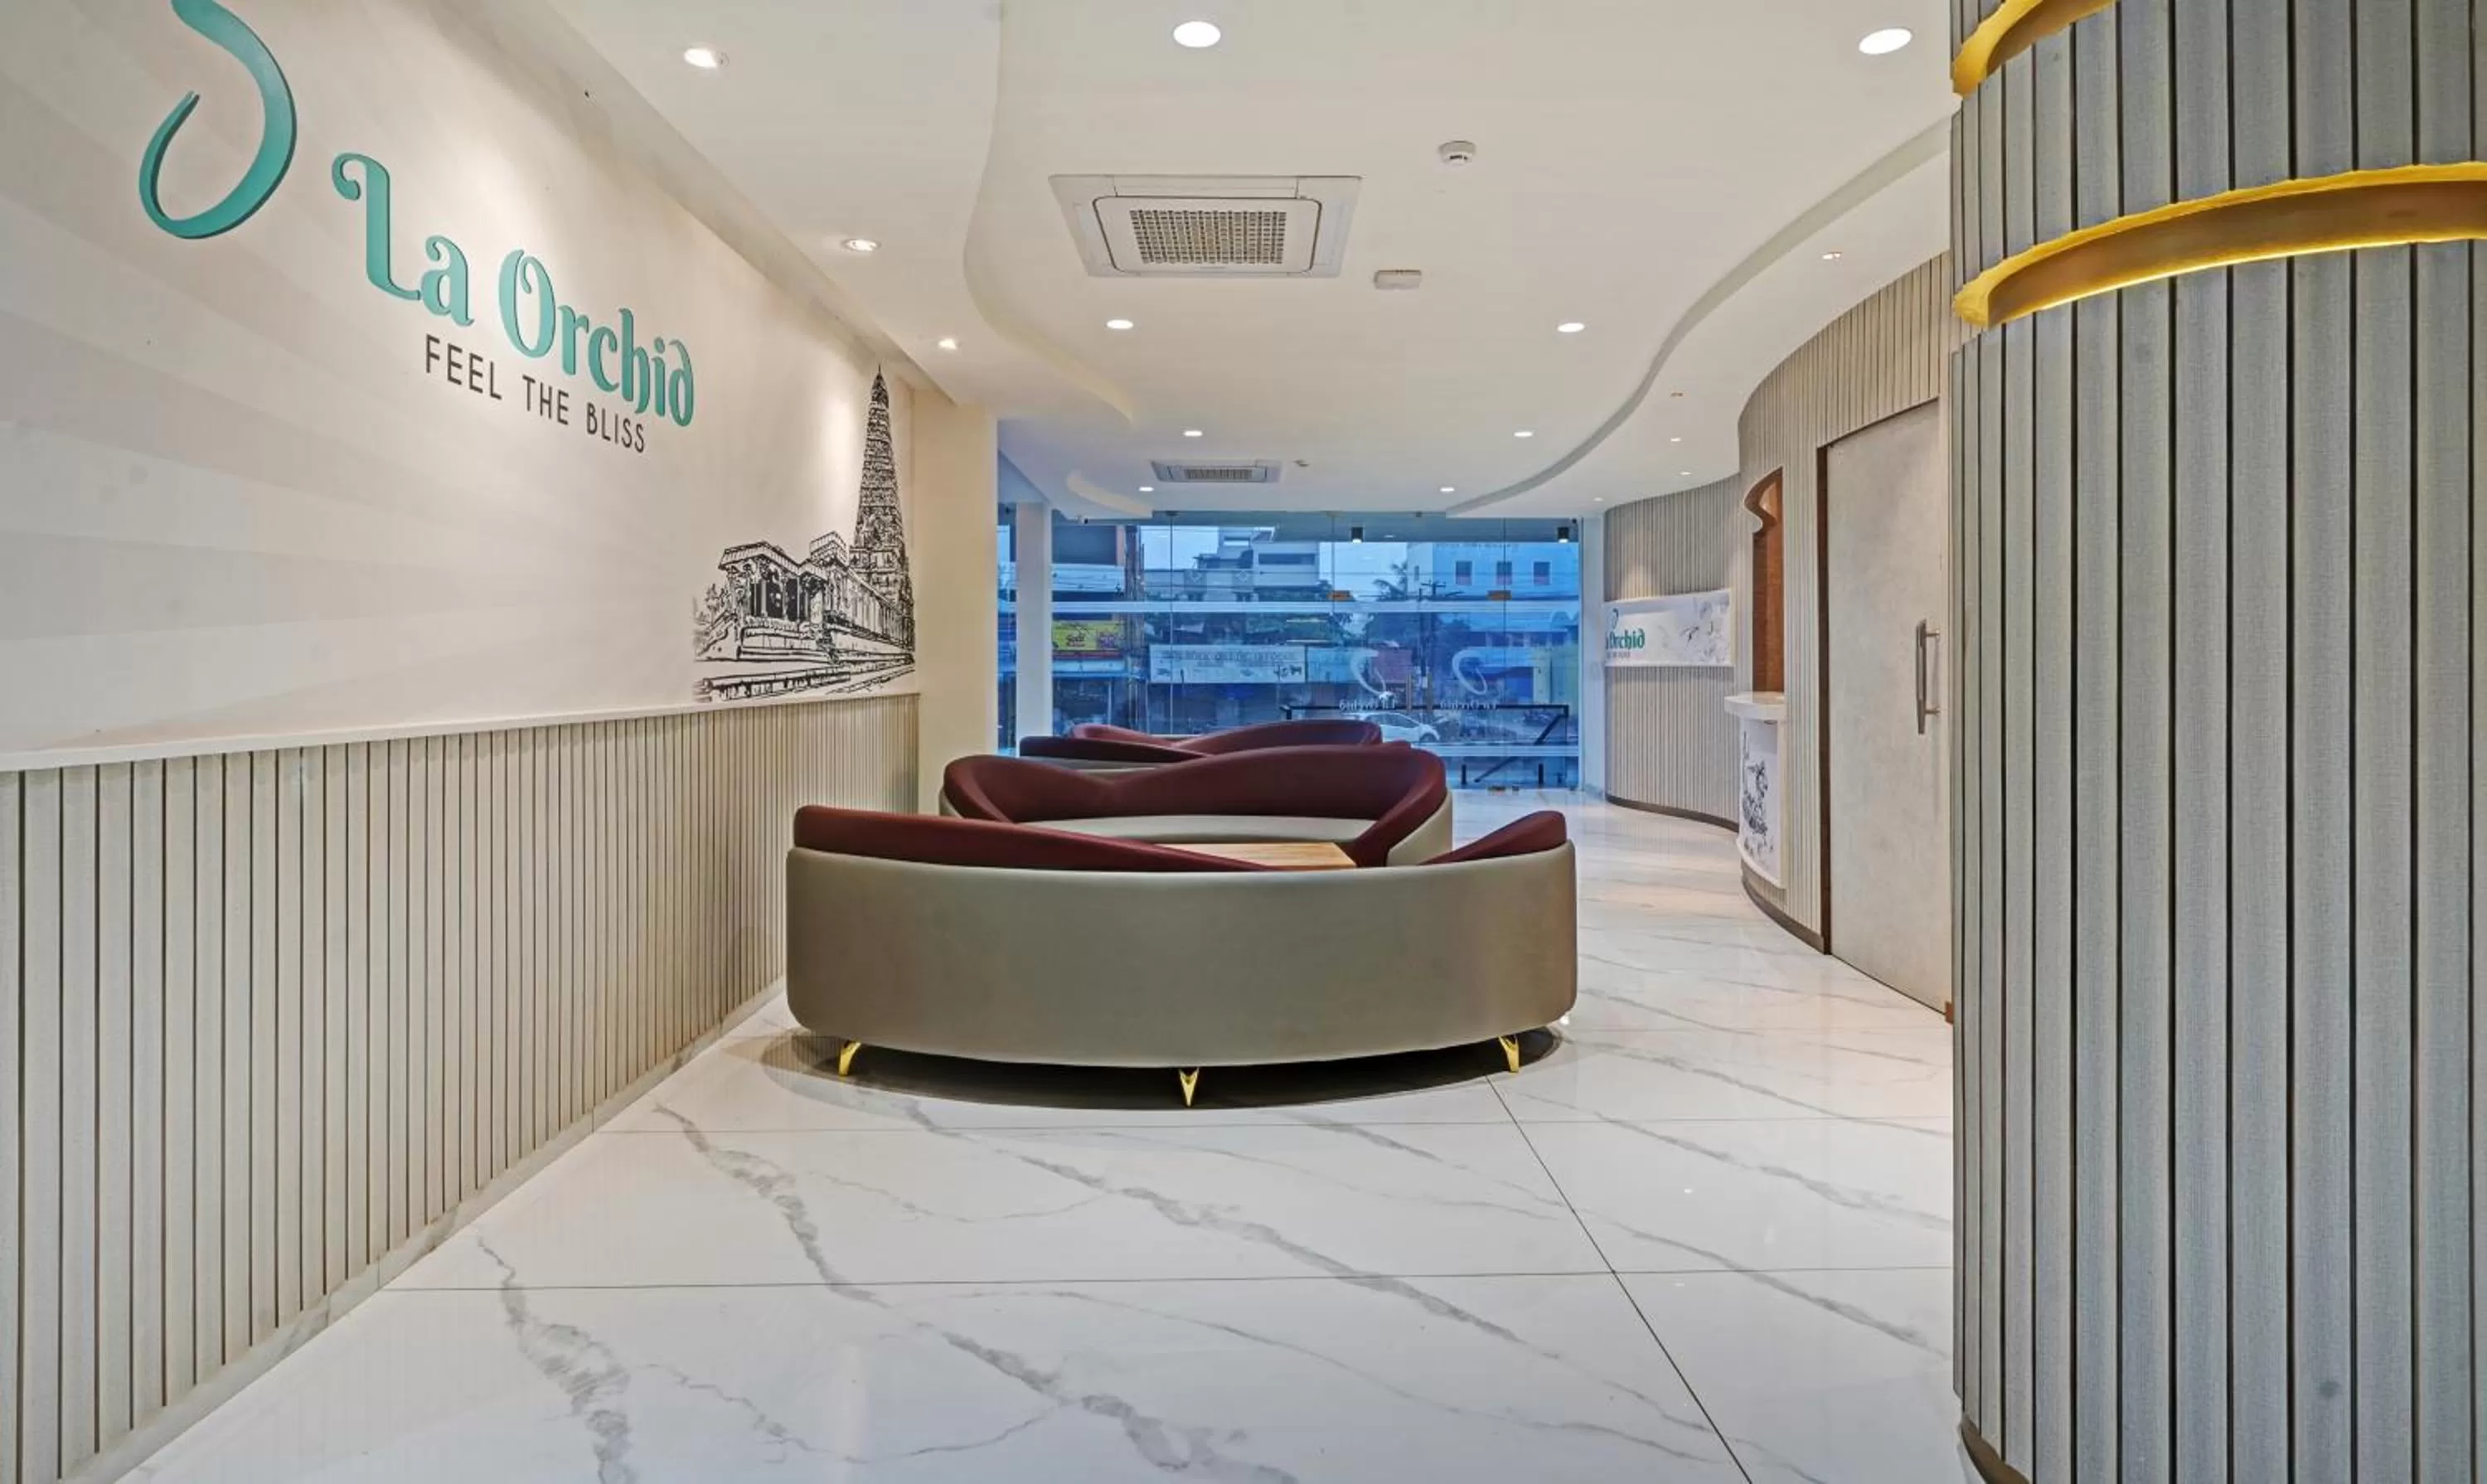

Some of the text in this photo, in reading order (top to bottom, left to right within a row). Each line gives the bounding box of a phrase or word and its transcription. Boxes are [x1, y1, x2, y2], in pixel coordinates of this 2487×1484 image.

[332, 153, 694, 427] La Orchid
[425, 334, 645, 453] FEEL THE BLISS
